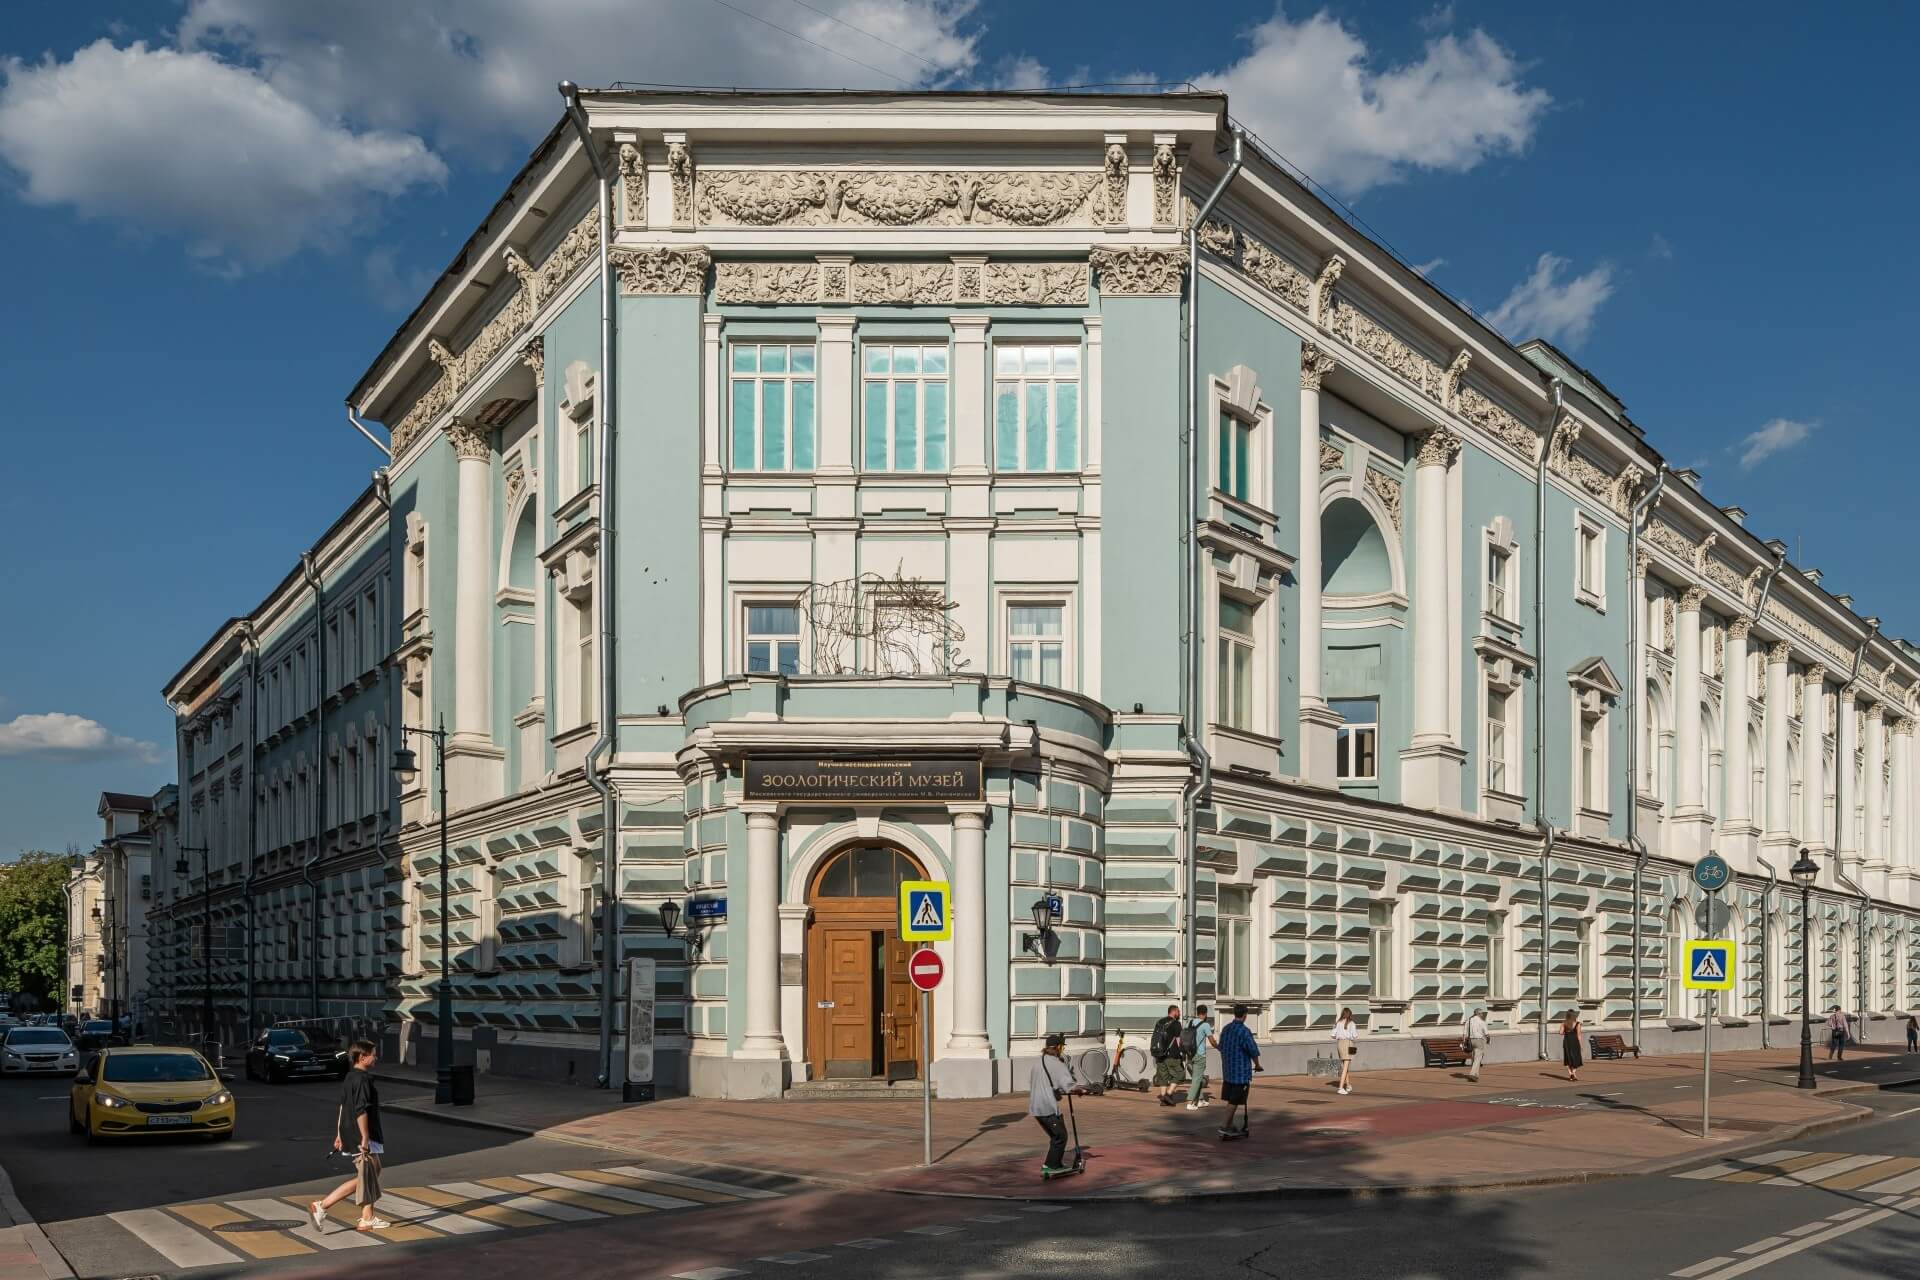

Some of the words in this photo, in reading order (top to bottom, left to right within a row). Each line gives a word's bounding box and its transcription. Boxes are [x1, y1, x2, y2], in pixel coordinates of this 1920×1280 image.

[761, 771, 903, 787] ЗООЛОГИЧЕСКИЙ
[909, 771, 964, 787] МУЗЕЙ
[1052, 900, 1059, 911] 2
